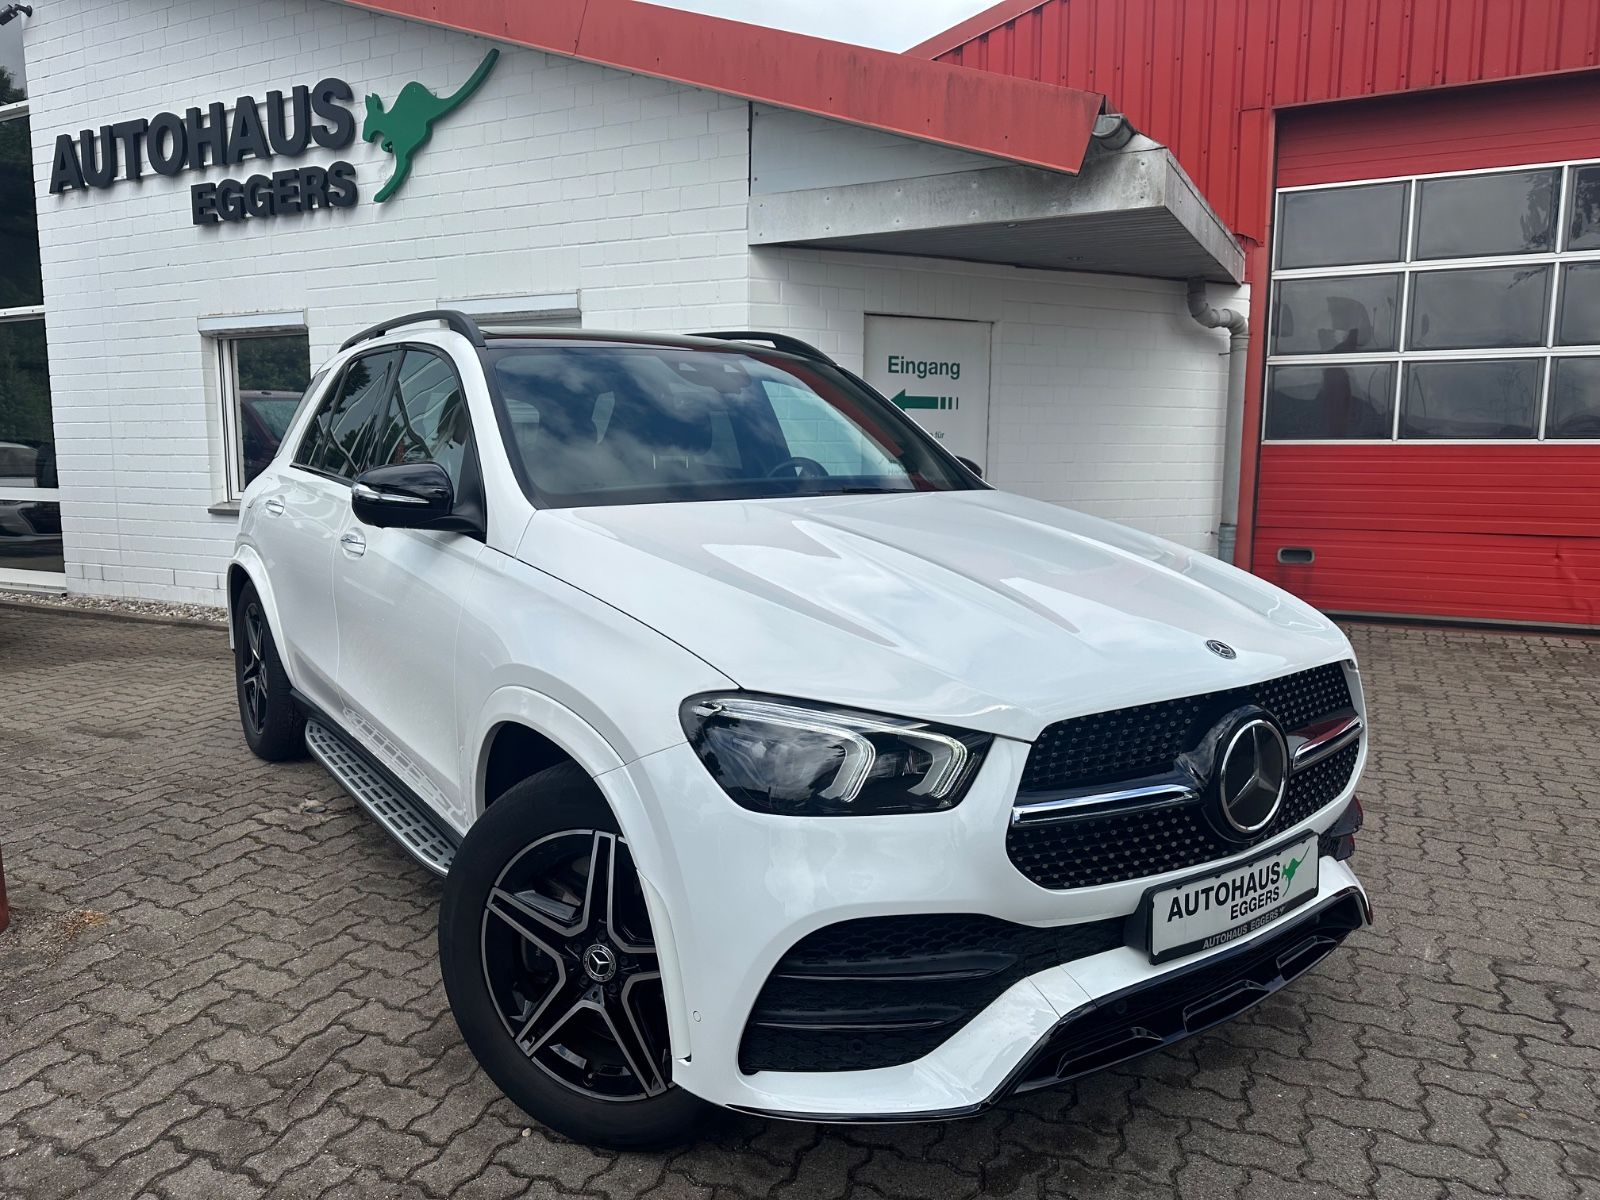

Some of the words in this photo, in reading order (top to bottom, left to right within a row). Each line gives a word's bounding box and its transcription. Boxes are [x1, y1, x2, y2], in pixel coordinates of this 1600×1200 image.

[49, 77, 354, 194] AUTOHAUS
[190, 161, 358, 225] EGGERS
[887, 355, 960, 380] Eingang
[1167, 861, 1281, 922] AUTOHAUS
[1230, 886, 1280, 920] EGGERS
[1202, 924, 1248, 949] AUTOHAUS
[1250, 908, 1279, 931] EGGERS
